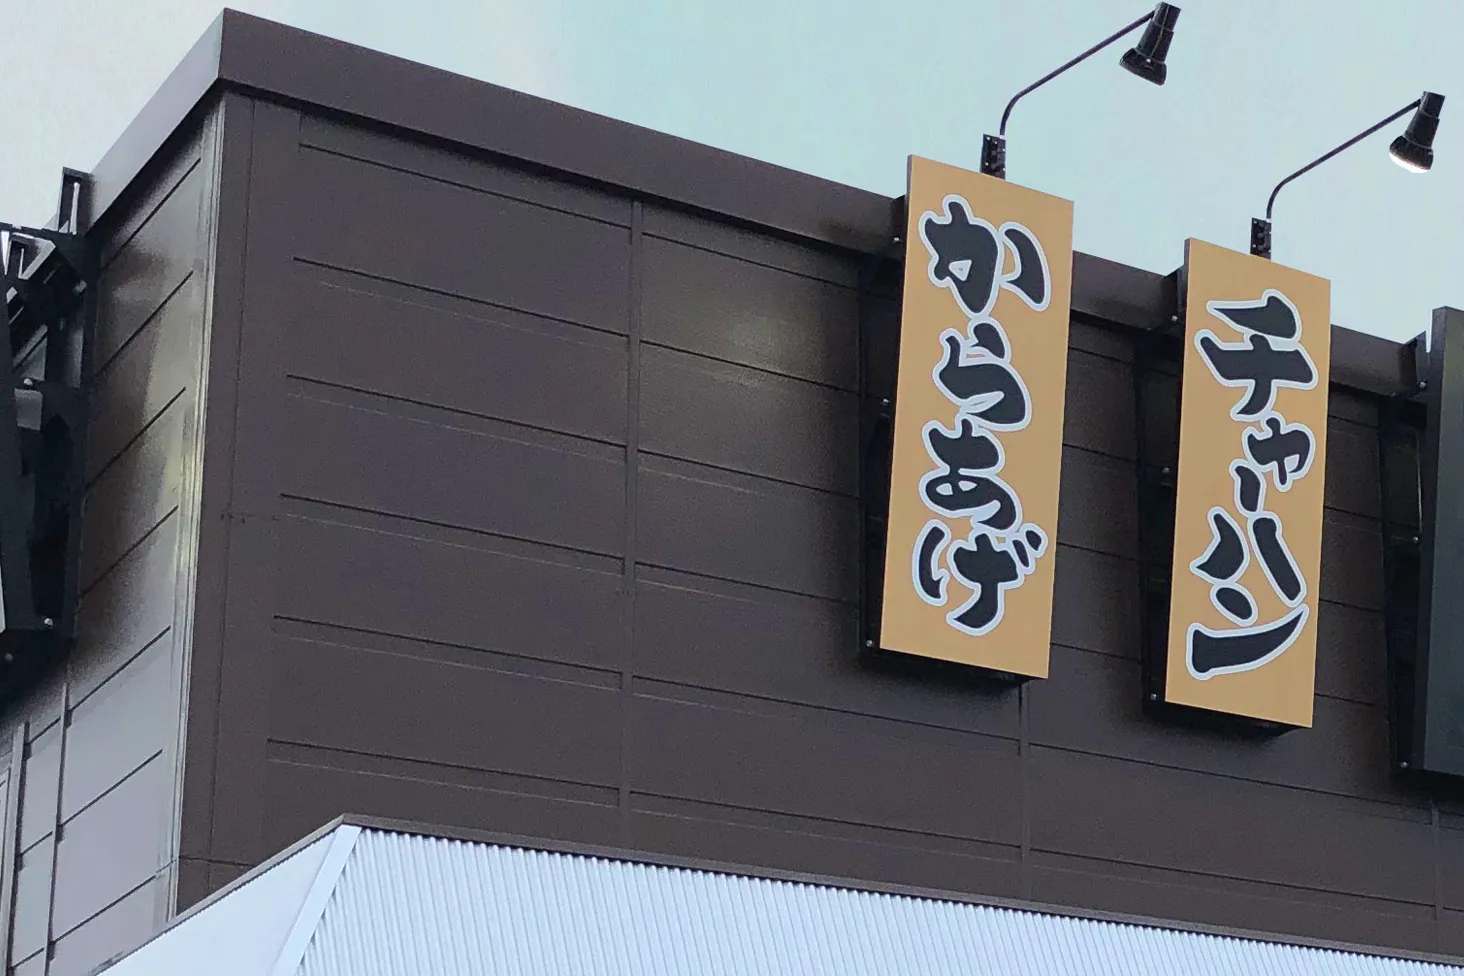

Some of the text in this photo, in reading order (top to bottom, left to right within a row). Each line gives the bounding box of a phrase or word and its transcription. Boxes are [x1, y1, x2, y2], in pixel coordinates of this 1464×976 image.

[912, 195, 1050, 634] からあげ
[1186, 289, 1318, 680] チャーハン
